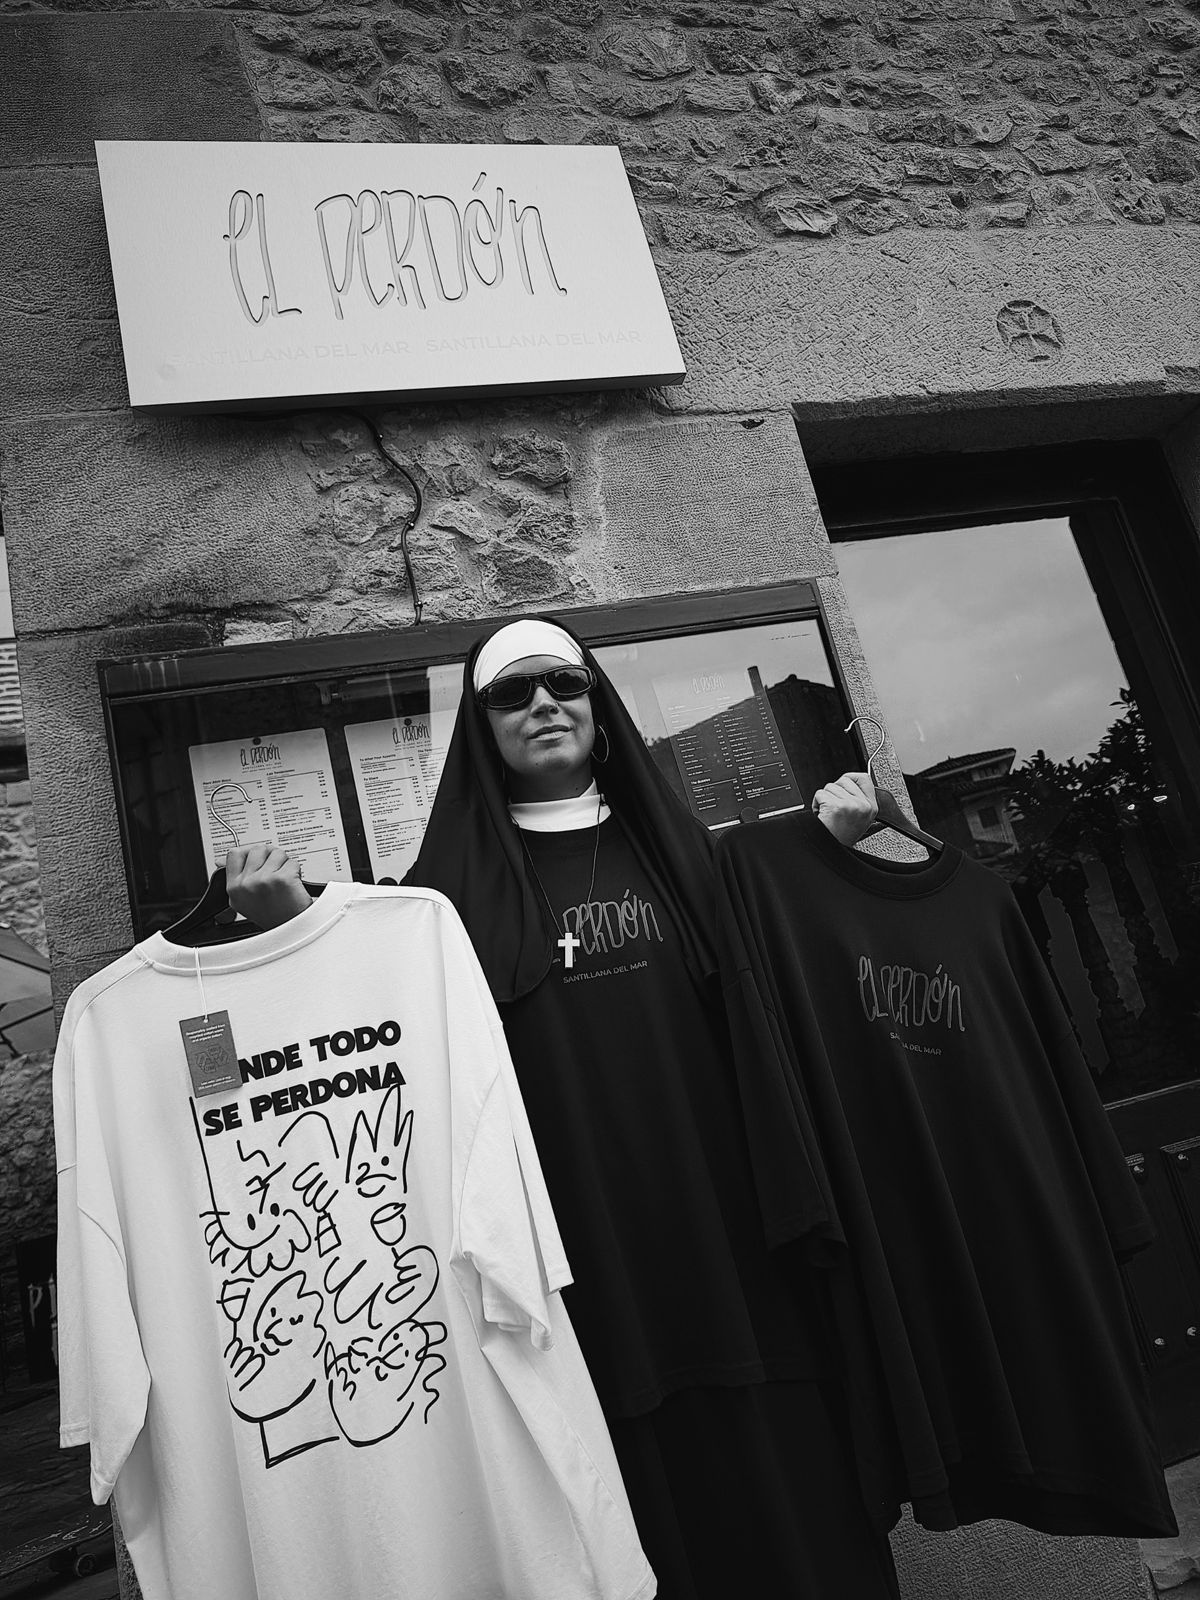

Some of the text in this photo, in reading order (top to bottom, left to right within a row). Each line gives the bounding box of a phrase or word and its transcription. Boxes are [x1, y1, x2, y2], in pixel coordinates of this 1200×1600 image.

[166, 329, 643, 368] SANTILLANA DEL MAR SANTILLANA DEL MAR
[563, 960, 648, 984] SANTILLANA DEL MAR
[238, 1020, 402, 1084] NDE TODO
[909, 1044, 942, 1056] DEL MAR
[202, 1061, 407, 1137] SE PERDONA
